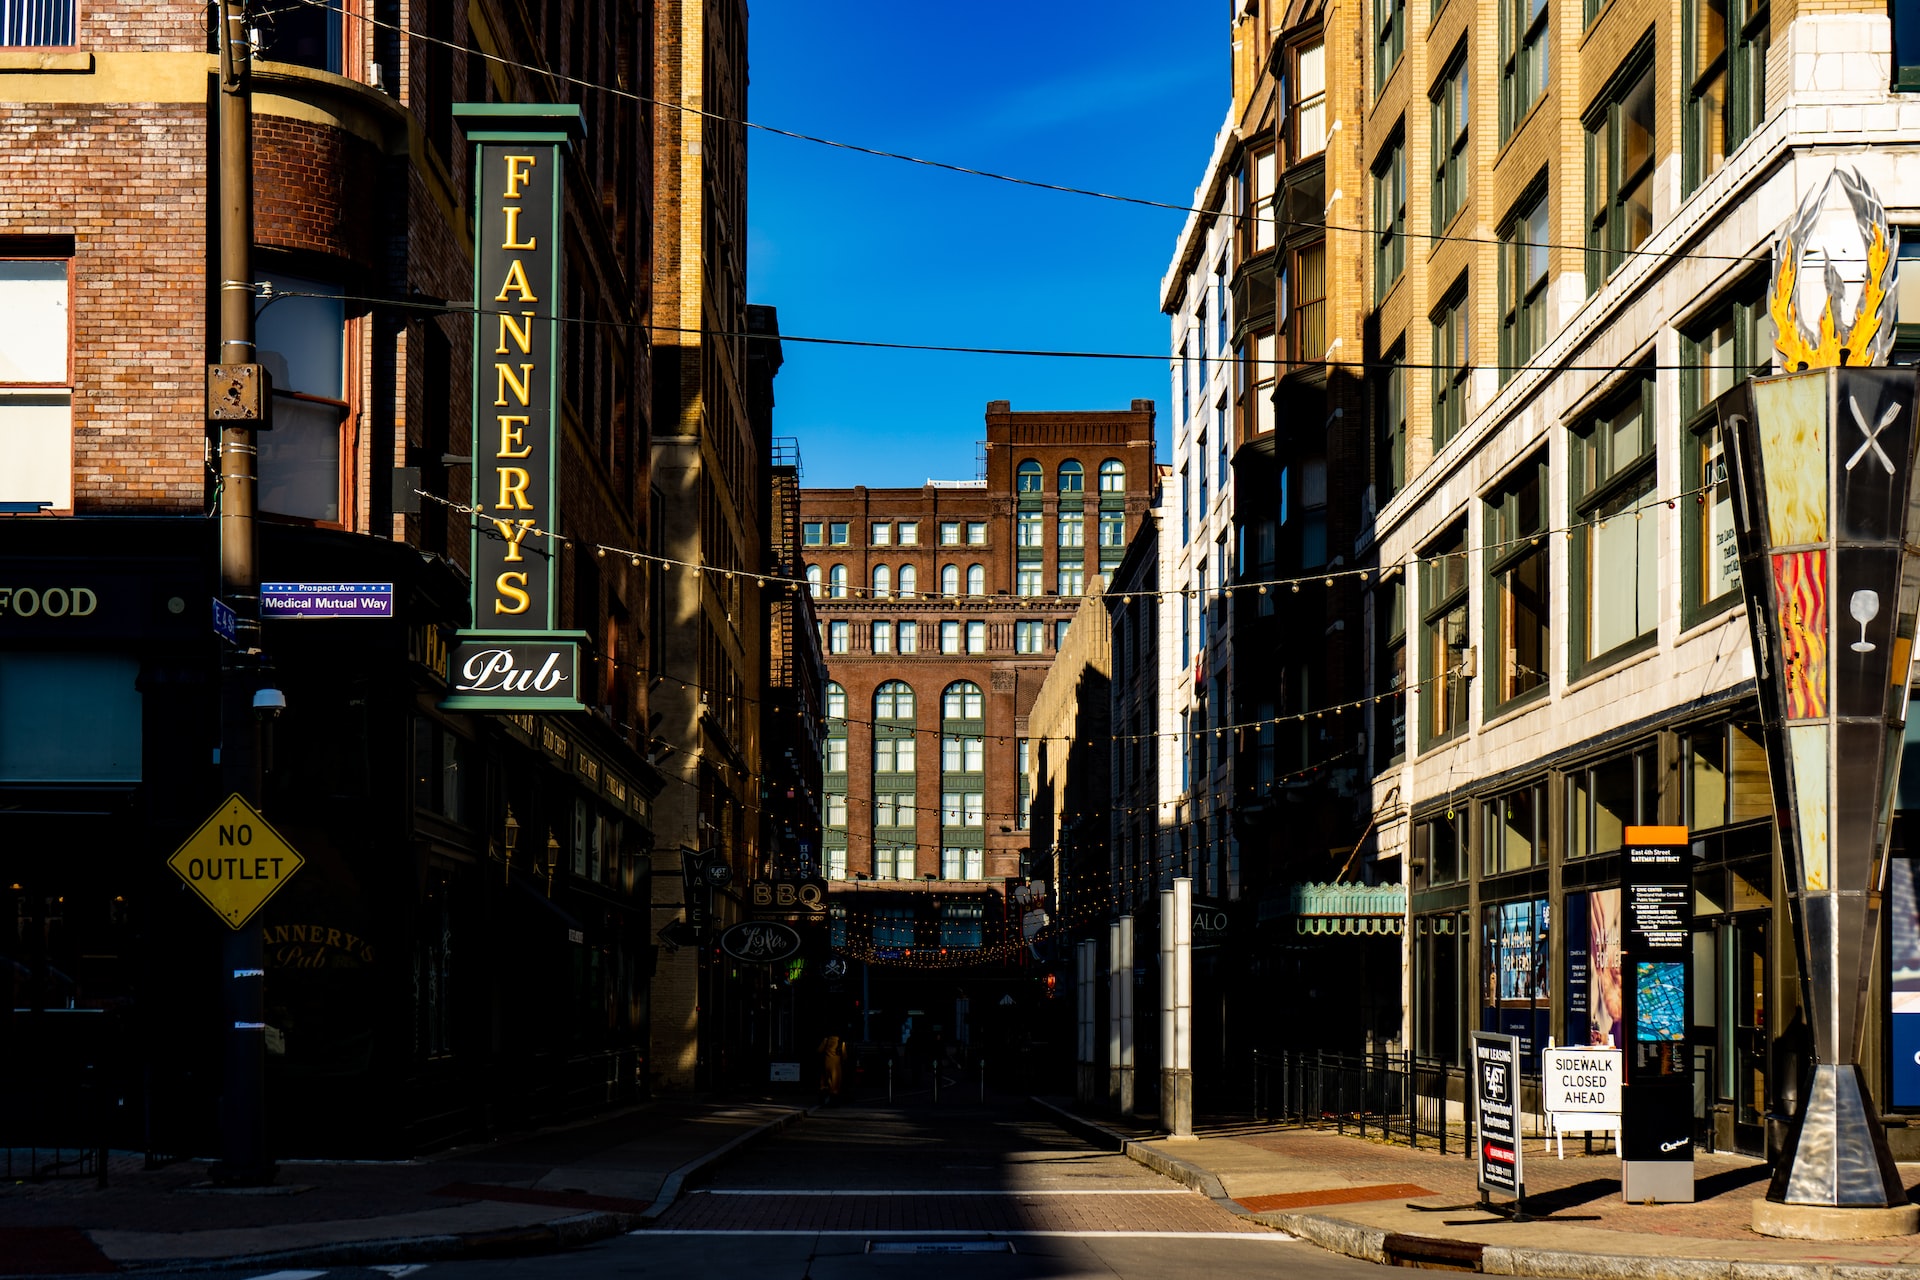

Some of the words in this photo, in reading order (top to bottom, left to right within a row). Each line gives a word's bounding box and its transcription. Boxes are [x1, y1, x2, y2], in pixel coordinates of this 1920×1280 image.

[493, 155, 539, 616] FLANNERYS
[298, 583, 335, 594] Prospect
[339, 583, 355, 592] Ave
[0, 587, 99, 618] FOOD
[265, 595, 312, 611] Medical
[315, 595, 358, 611] Mutual
[361, 596, 388, 614] Way
[455, 648, 569, 692] Pub
[219, 824, 252, 846] NO
[188, 857, 283, 881] OUTLET
[692, 859, 703, 937] VALET
[753, 883, 826, 911] BBQ
[1555, 1058, 1612, 1072] SIDEWALK
[1562, 1075, 1607, 1088] CLOSED
[1564, 1092, 1605, 1104] AHEAD
